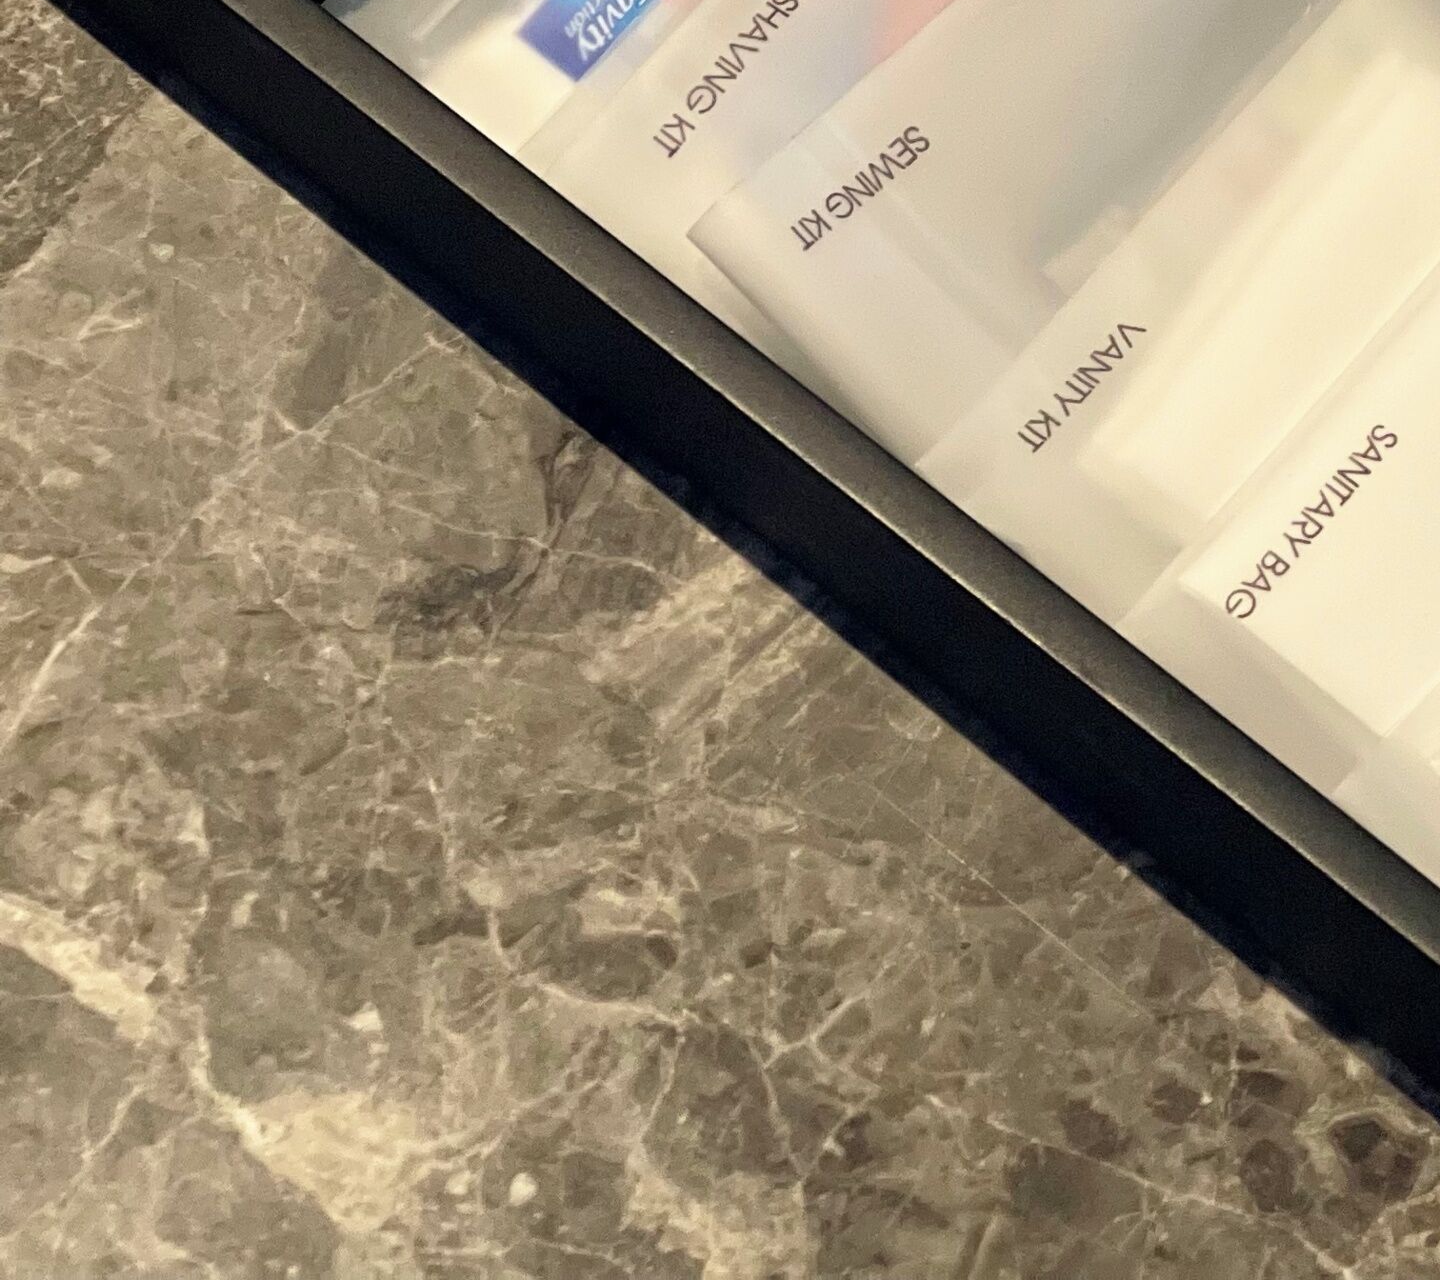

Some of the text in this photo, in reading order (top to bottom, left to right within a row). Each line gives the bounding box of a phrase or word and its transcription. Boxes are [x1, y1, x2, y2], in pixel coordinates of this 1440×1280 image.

[652, 113, 696, 158] KIT
[789, 125, 931, 252] SEWING KIT
[1016, 321, 1148, 453] VANITY KIT
[1224, 423, 1399, 621] SANITARY BAG
